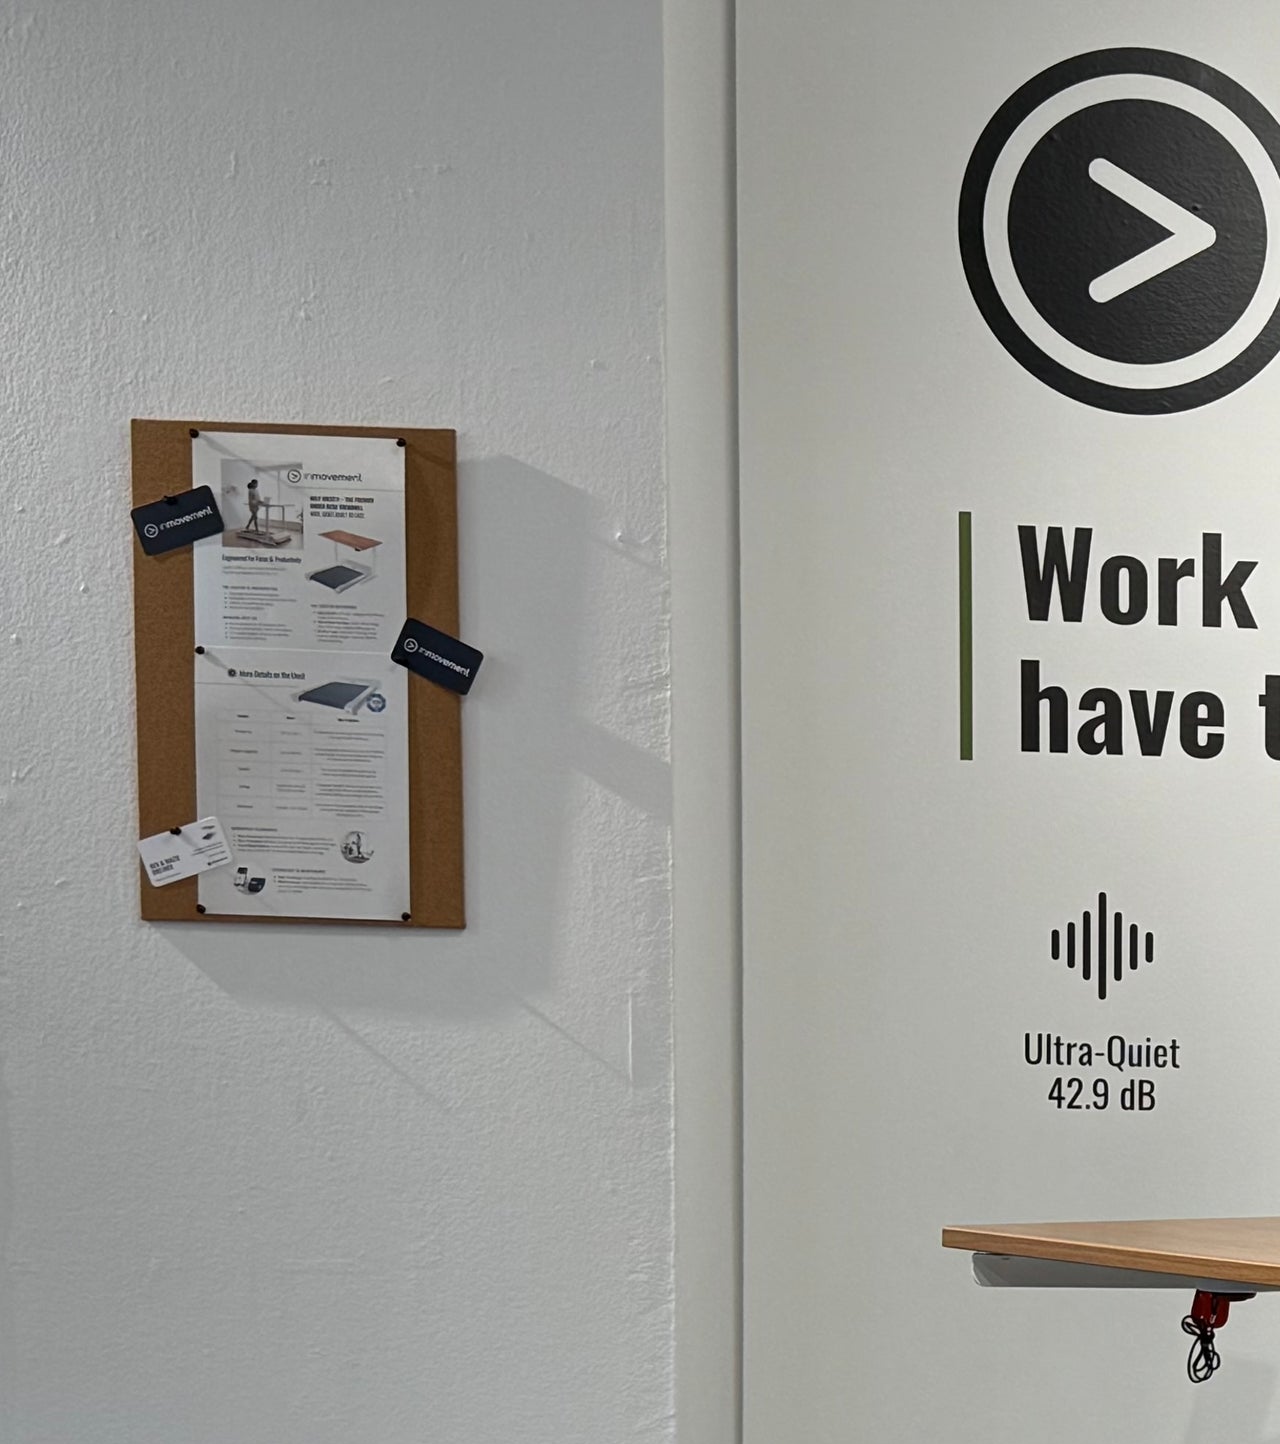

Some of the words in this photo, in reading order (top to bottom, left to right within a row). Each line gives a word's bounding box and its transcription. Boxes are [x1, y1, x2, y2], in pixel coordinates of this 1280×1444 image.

[1018, 525, 1258, 629] Work
[1021, 660, 1224, 759] have
[1025, 1033, 1180, 1072] Ultra-Quiet
[1048, 1077, 1109, 1111] 42.9
[1121, 1079, 1155, 1111] dB
